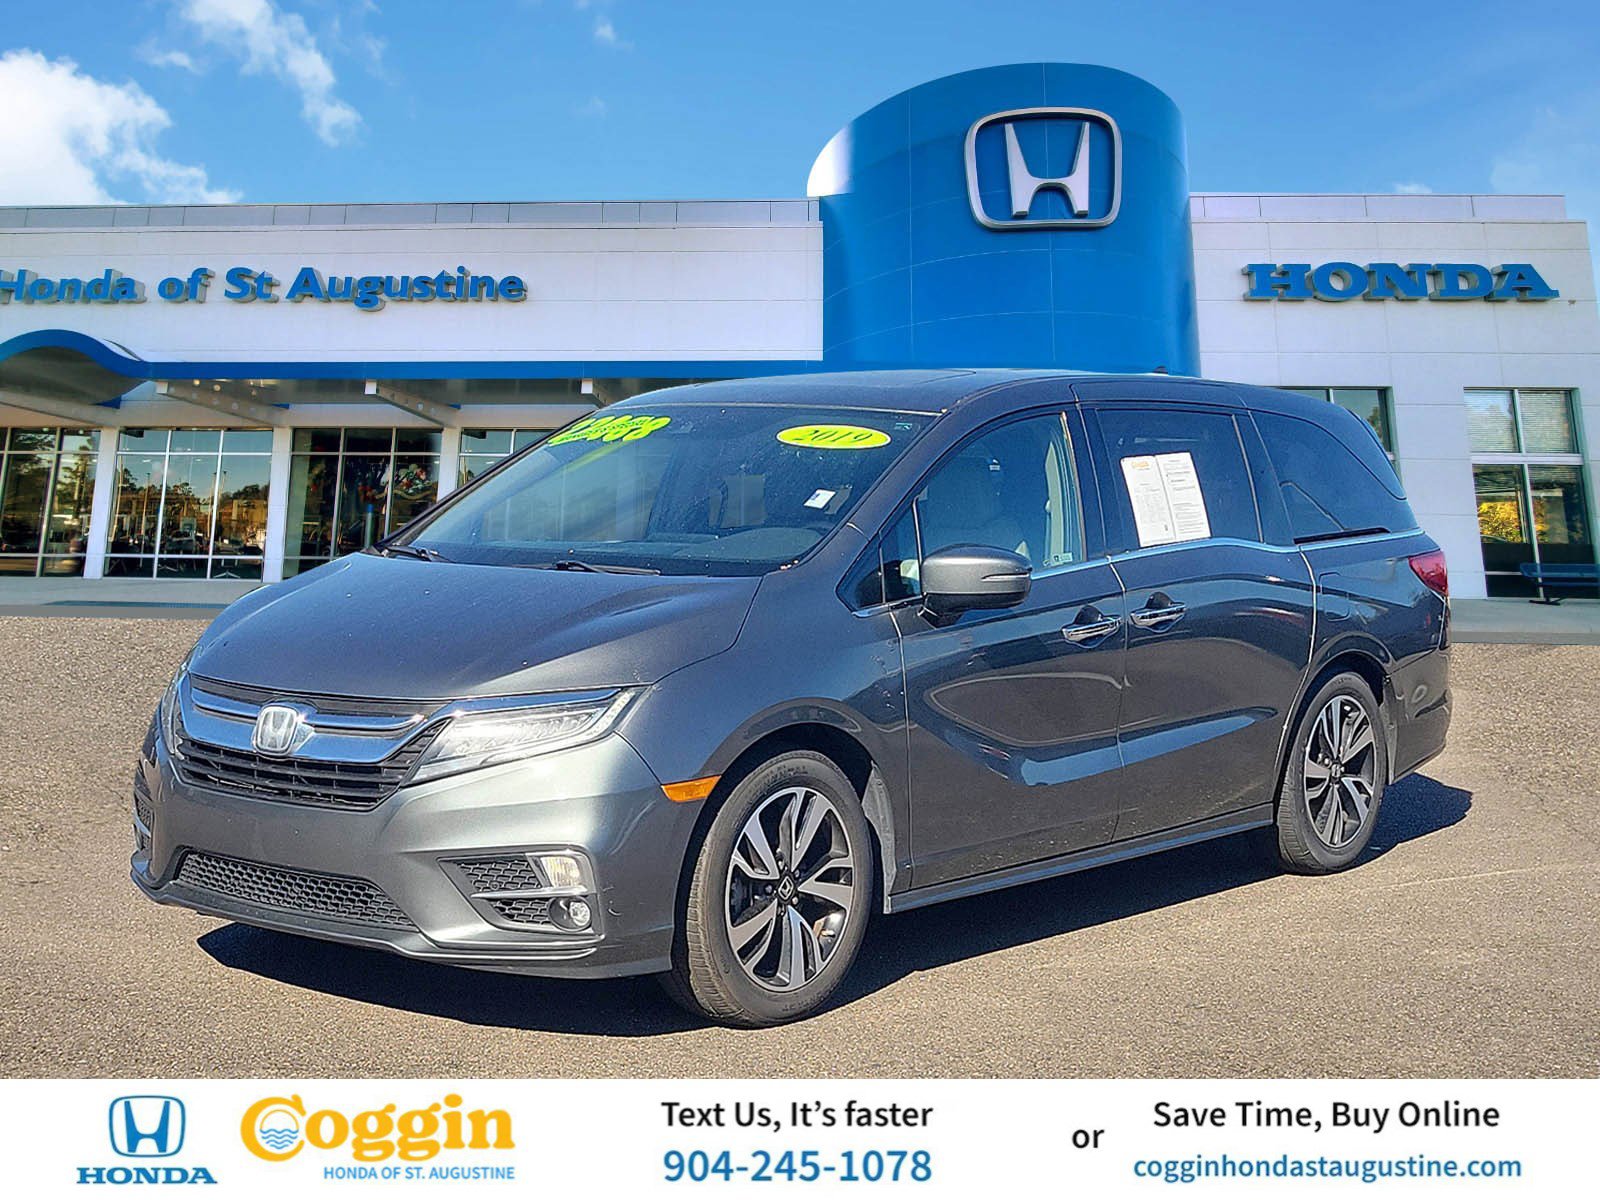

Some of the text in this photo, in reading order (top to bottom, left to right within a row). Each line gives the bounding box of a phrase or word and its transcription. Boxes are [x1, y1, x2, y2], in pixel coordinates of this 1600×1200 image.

[0, 265, 527, 311] Honda of St Augustine
[1243, 262, 1560, 301] HONDA
